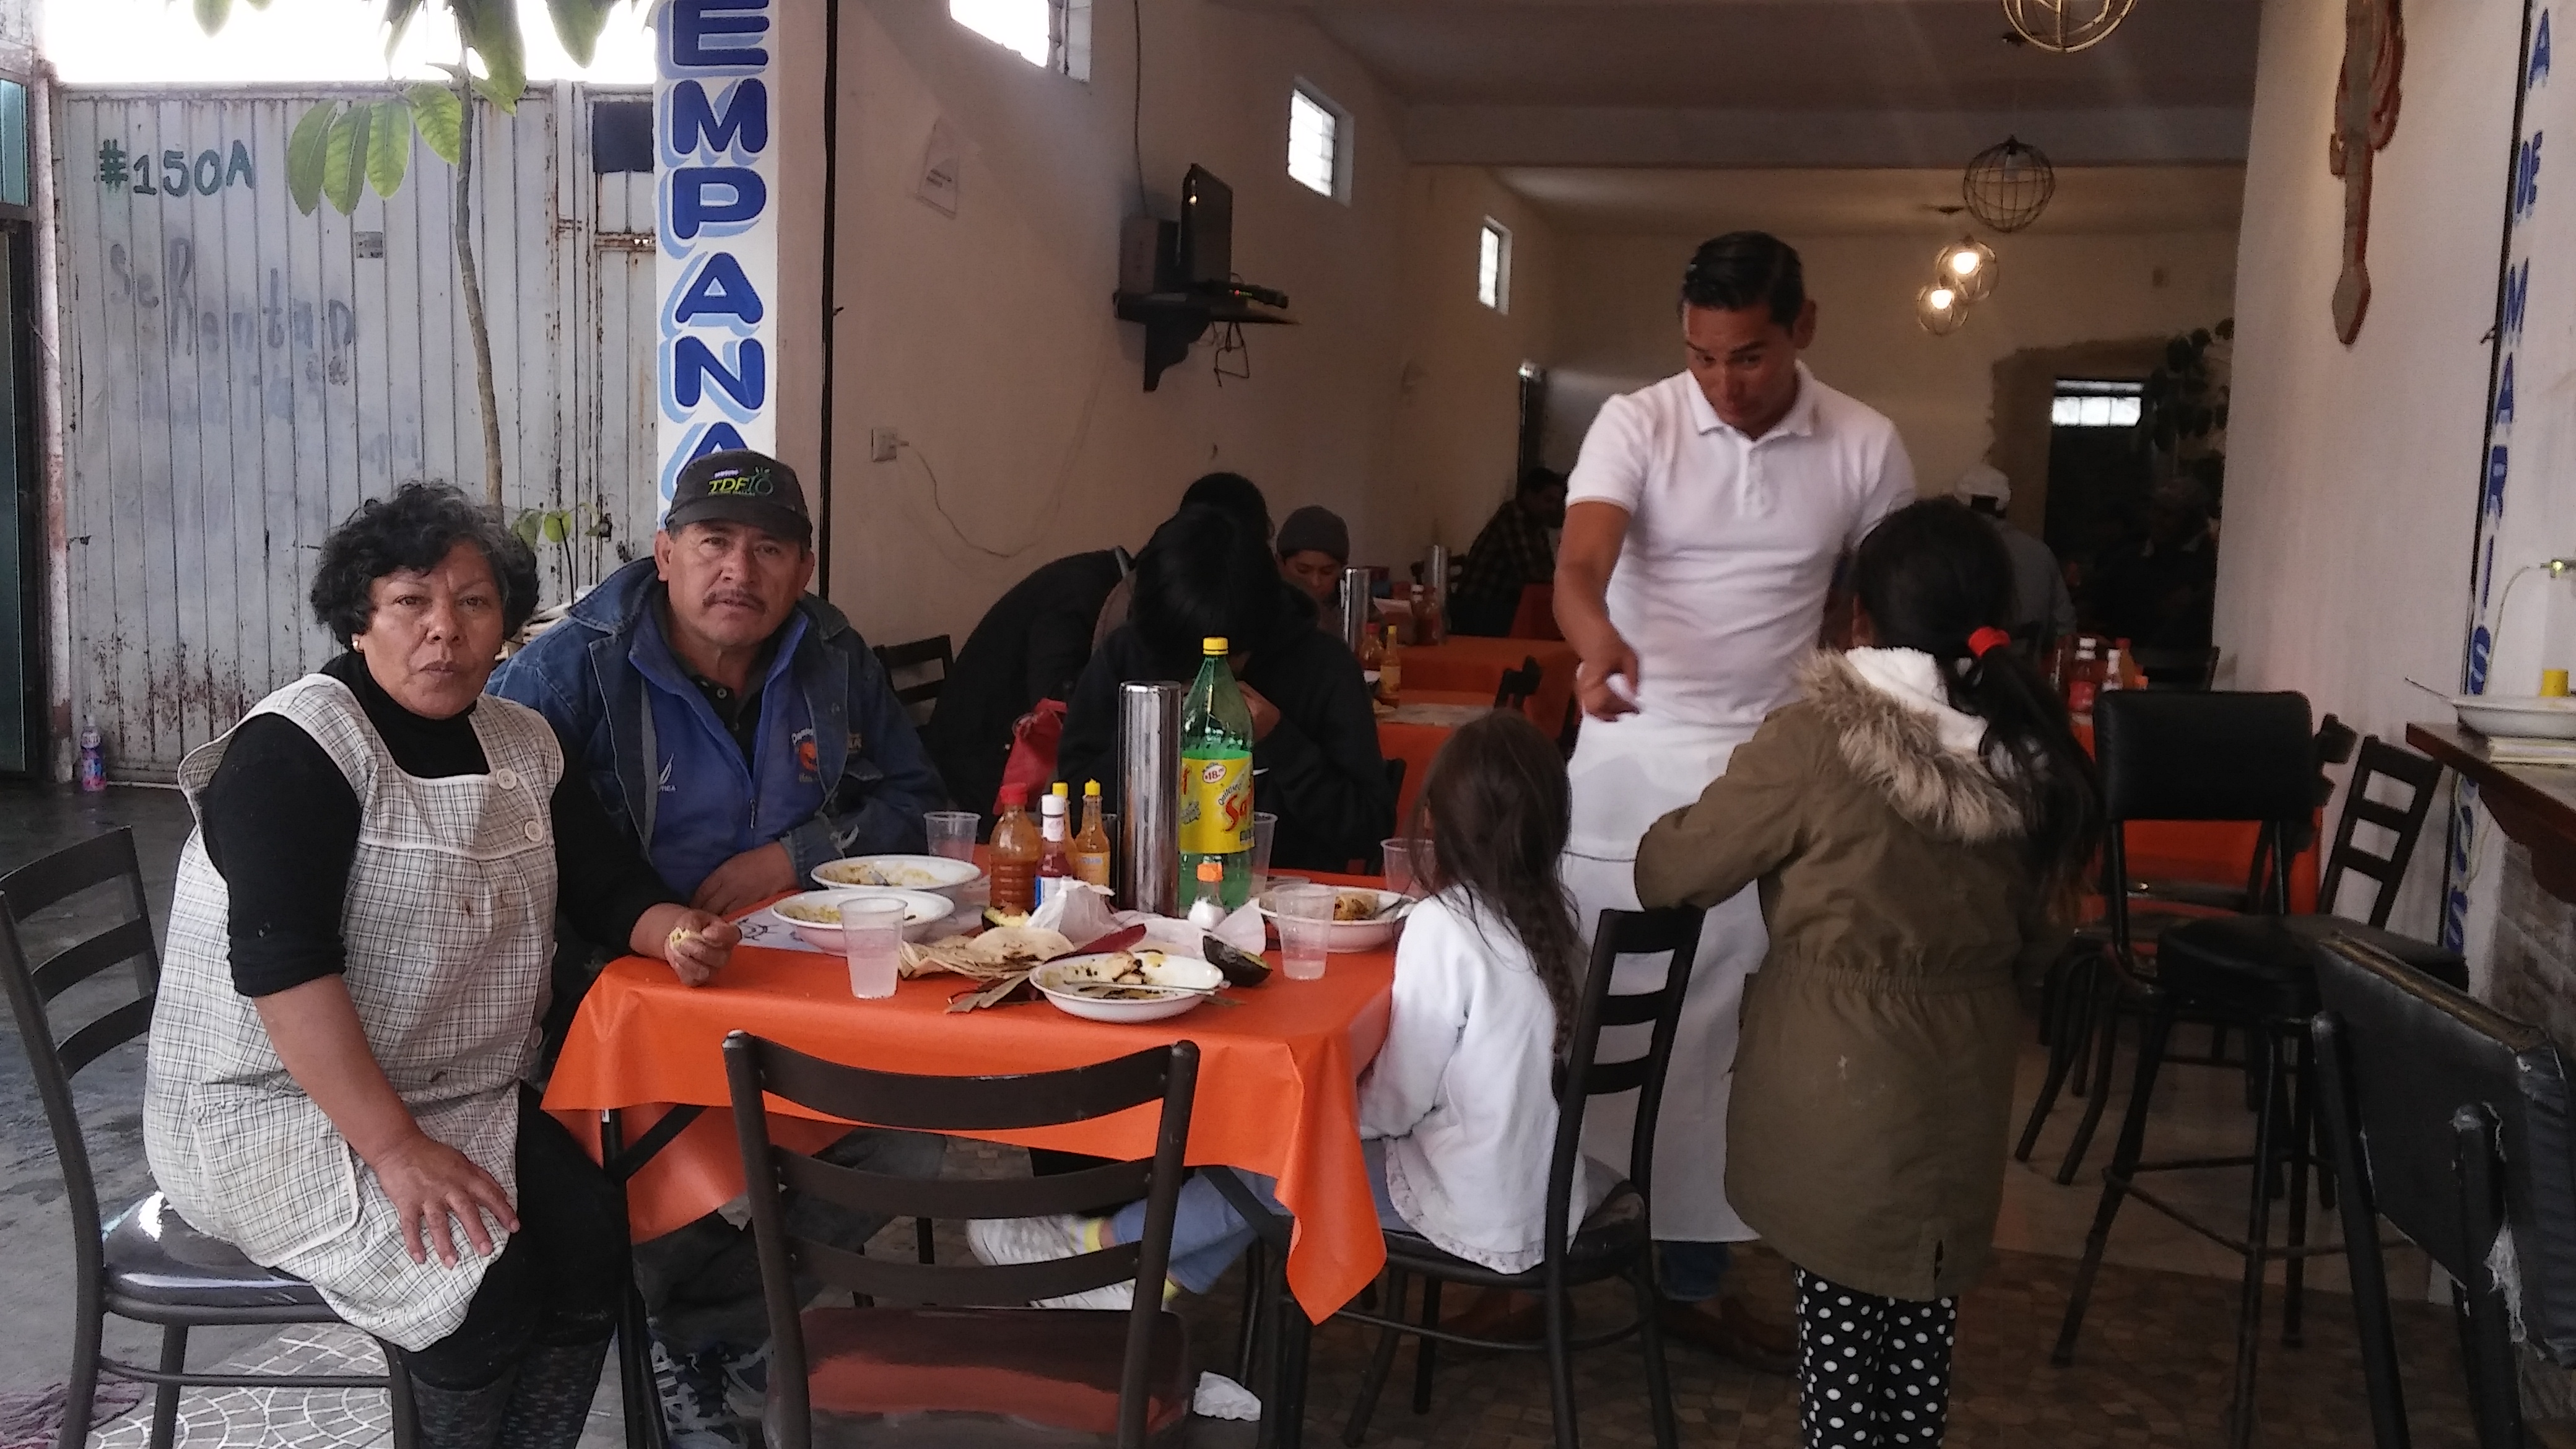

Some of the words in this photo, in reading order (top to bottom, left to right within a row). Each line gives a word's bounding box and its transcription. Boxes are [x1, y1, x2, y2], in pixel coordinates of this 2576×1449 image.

[98, 139, 255, 197] #150A
[661, 0, 770, 492] EMPANA
[2445, 255, 2530, 956] MARISOS
